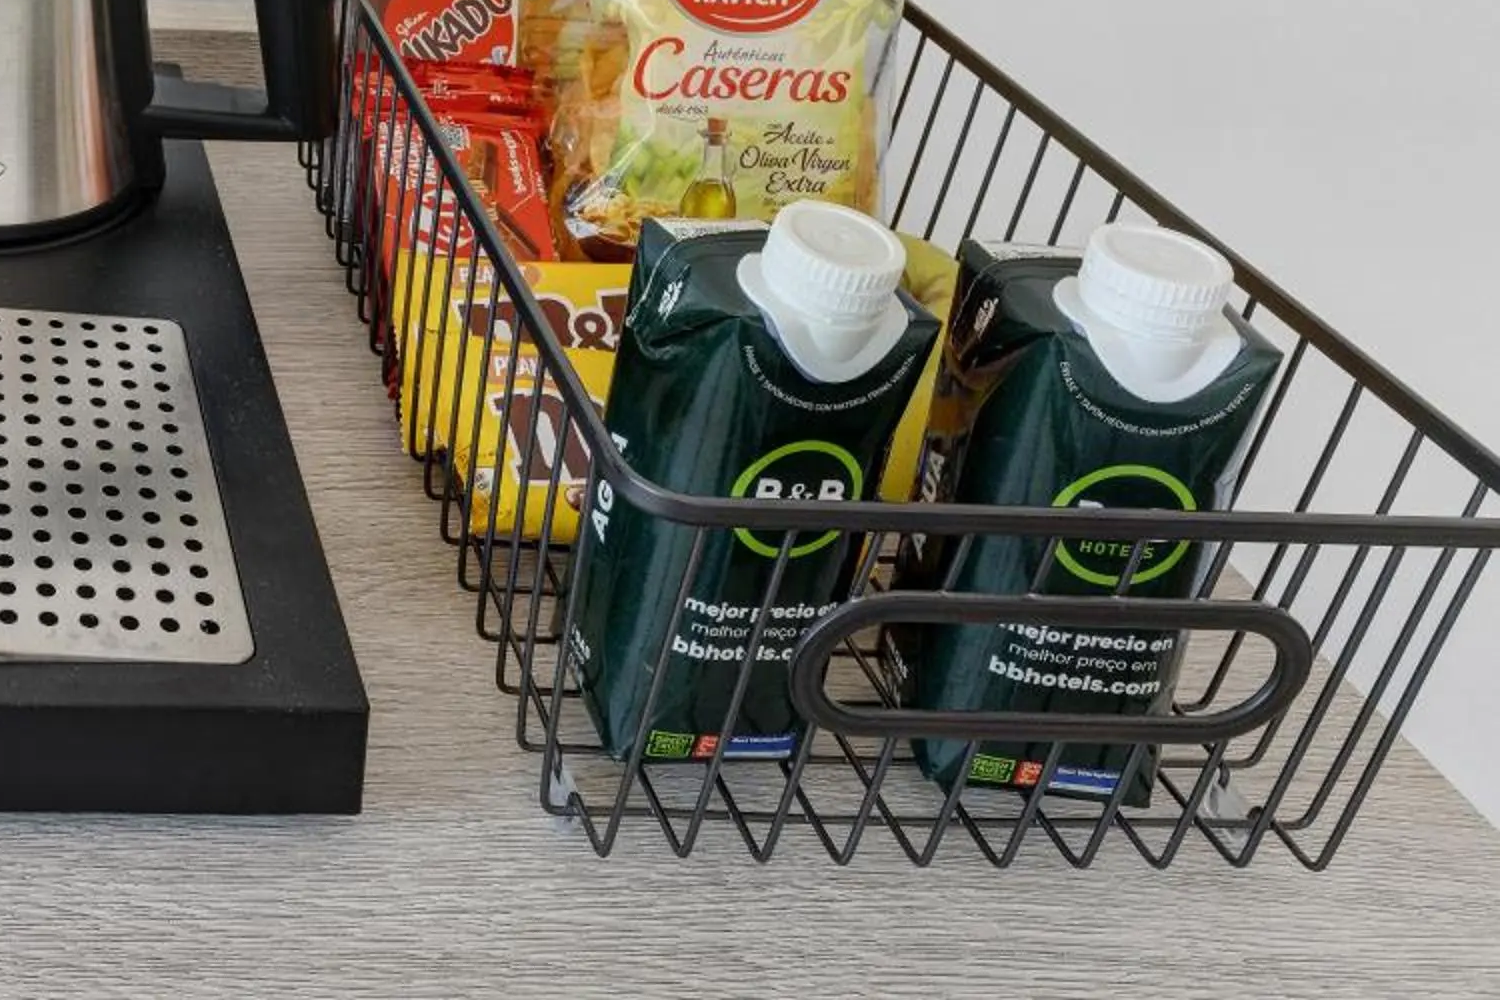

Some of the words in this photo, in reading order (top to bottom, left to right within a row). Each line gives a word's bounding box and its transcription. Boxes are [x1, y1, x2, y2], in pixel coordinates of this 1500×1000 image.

[633, 37, 851, 104] Caseras
[739, 146, 790, 169] Oliva
[791, 147, 850, 174] Virgen
[765, 171, 826, 194] Extra
[591, 431, 629, 545] AGA
[1079, 540, 1154, 560] HOTES
[684, 597, 749, 622] mejor
[691, 622, 749, 639] melhor
[763, 628, 797, 641] reço
[1074, 633, 1147, 652] precio
[1150, 638, 1174, 653] en
[672, 634, 793, 662] bbhotls.c
[1009, 642, 1075, 665] melhor
[1076, 655, 1127, 673] preço
[1131, 660, 1158, 672] em
[989, 654, 1160, 696] bbhotels.com
